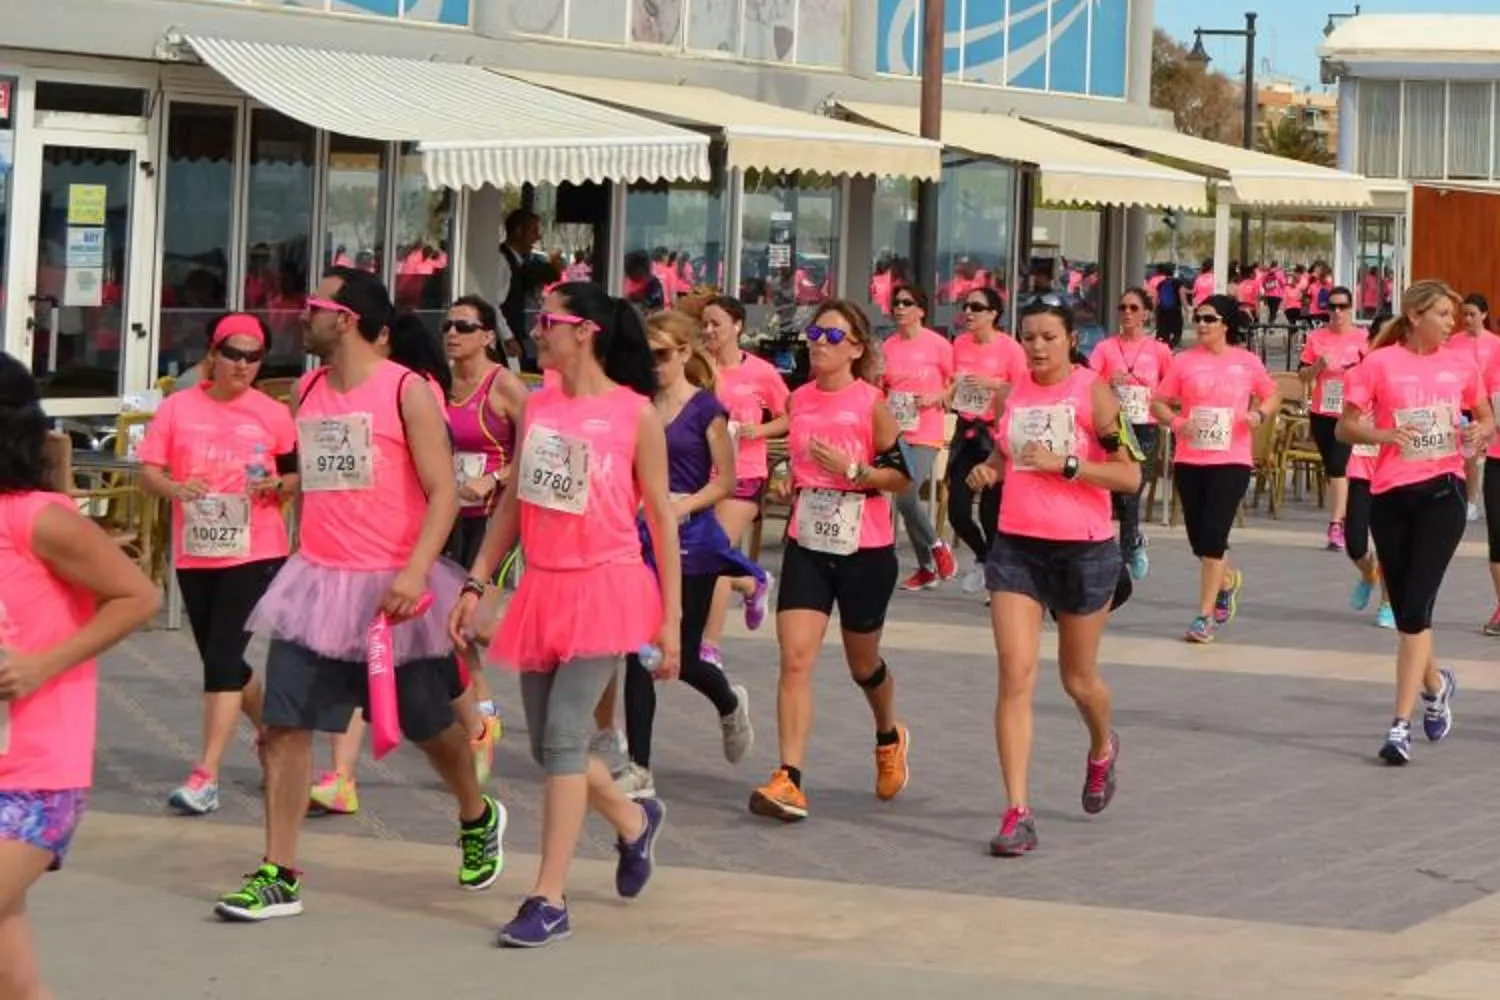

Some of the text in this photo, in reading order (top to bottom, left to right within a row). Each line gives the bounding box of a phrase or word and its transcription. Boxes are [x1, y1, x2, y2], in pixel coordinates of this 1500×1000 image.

[317, 455, 356, 472] 9729
[533, 467, 573, 493] 9780
[193, 526, 239, 541] 10027
[814, 520, 841, 537] 929
